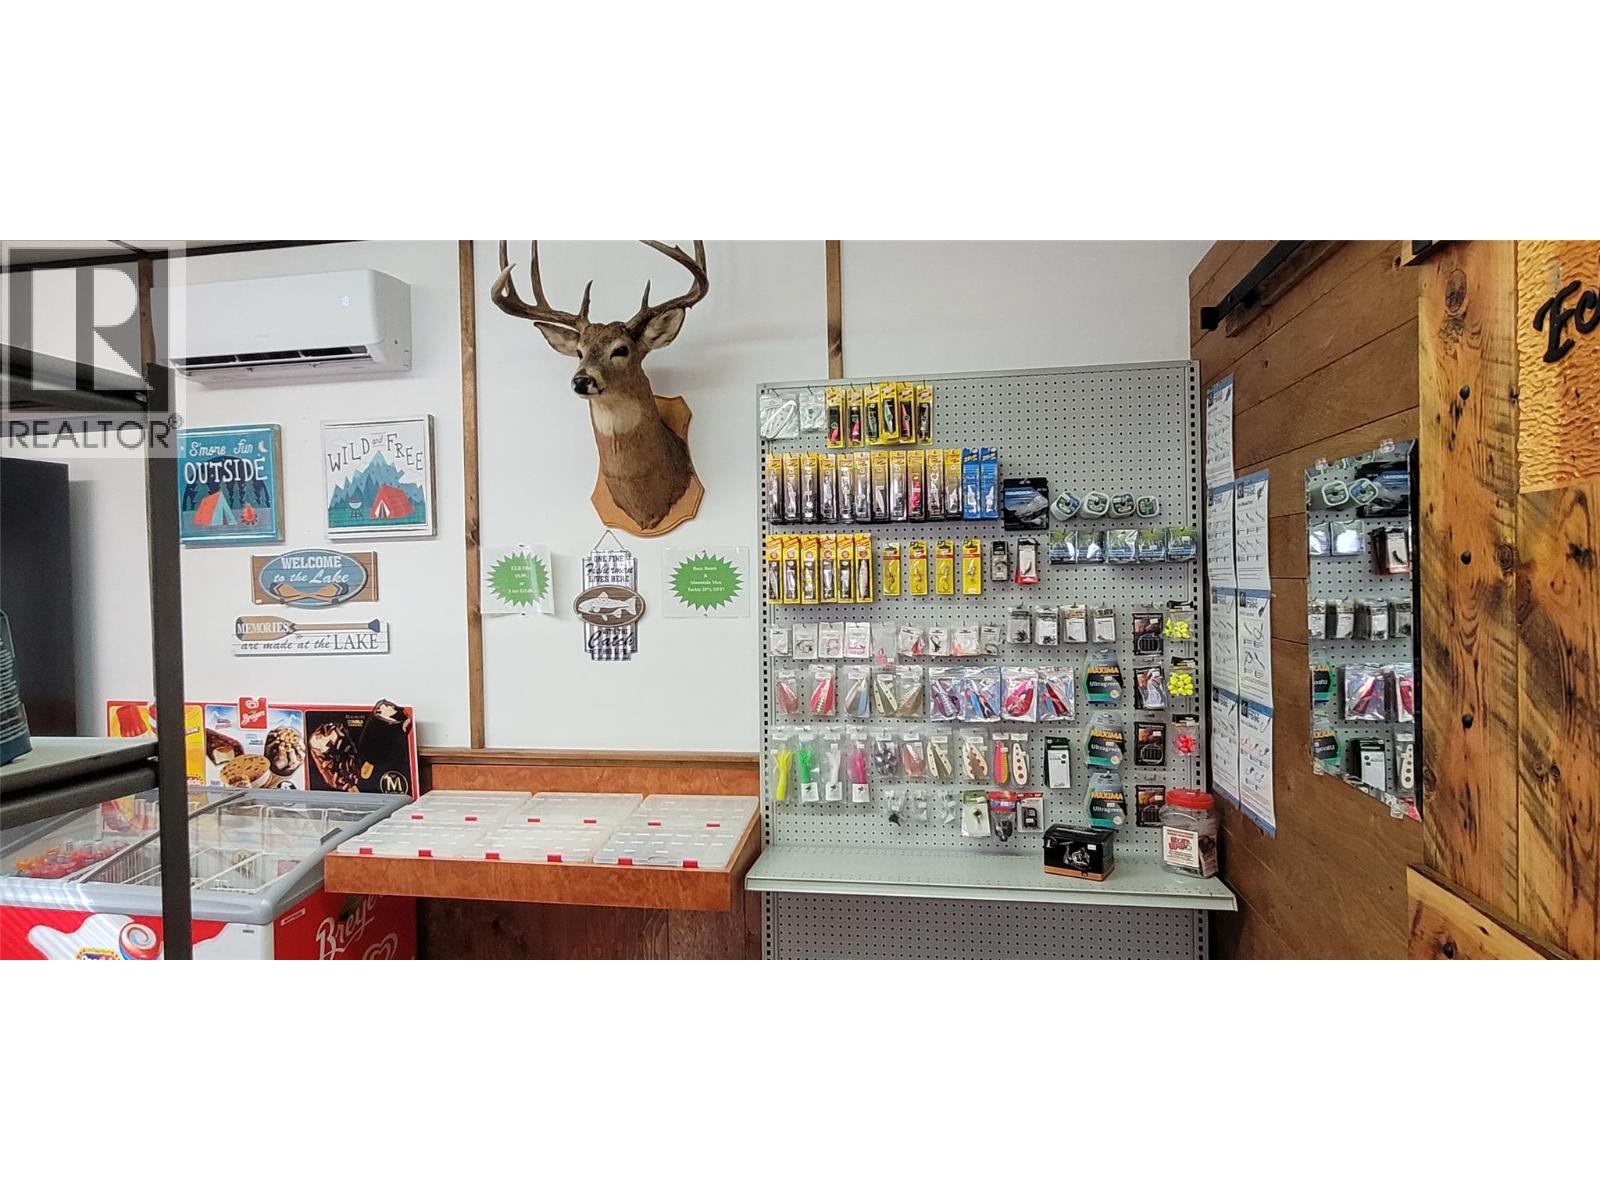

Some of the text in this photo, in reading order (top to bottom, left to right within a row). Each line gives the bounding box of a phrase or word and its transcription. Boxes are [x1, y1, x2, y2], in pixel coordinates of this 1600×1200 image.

[328, 438, 370, 472] WILD
[387, 433, 423, 470] FREE
[184, 457, 268, 484] OUTSIDE
[281, 556, 342, 569] WELCOME
[273, 569, 350, 584] to the Lake
[588, 575, 630, 583] LIVES HERE
[237, 622, 289, 633] MEMORIES
[241, 633, 379, 650] are made at the LAKE
[1087, 666, 1119, 674] MAXIMA
[1090, 729, 1122, 739] MAXIMA
[1091, 792, 1123, 800] MAXIMA
